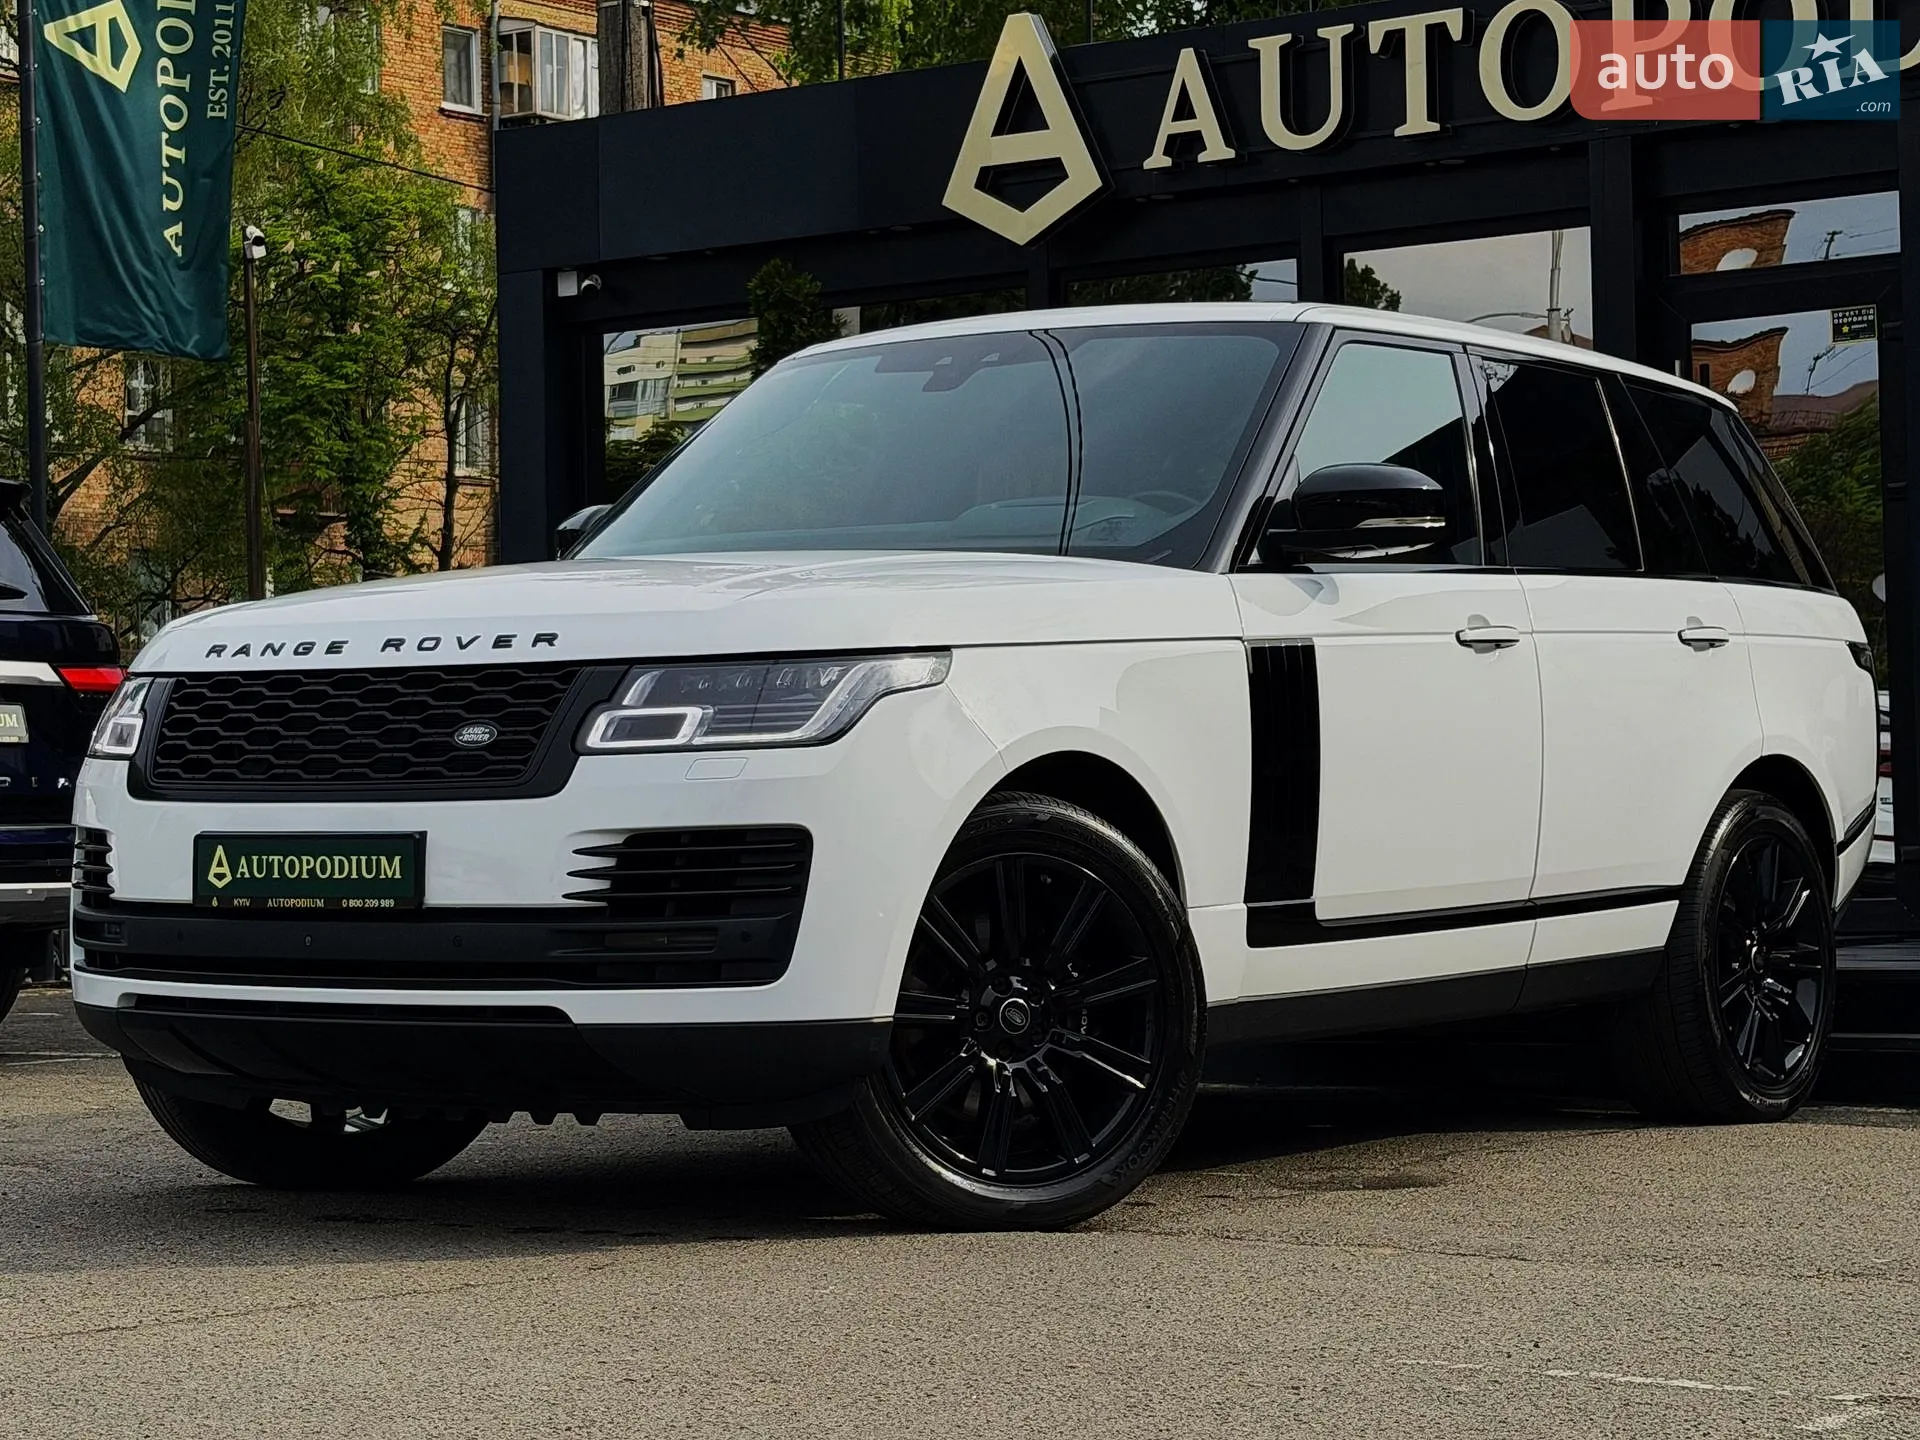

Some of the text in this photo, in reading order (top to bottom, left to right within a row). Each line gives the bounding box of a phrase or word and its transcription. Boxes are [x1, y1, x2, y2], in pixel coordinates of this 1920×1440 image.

[207, 1, 236, 119] EST. 2011
[205, 632, 559, 658] RANGE ROVER
[236, 855, 402, 879] AUTOPODIUM
[233, 898, 394, 908] KYIV AUTOPODIUM 0 800 209 989
